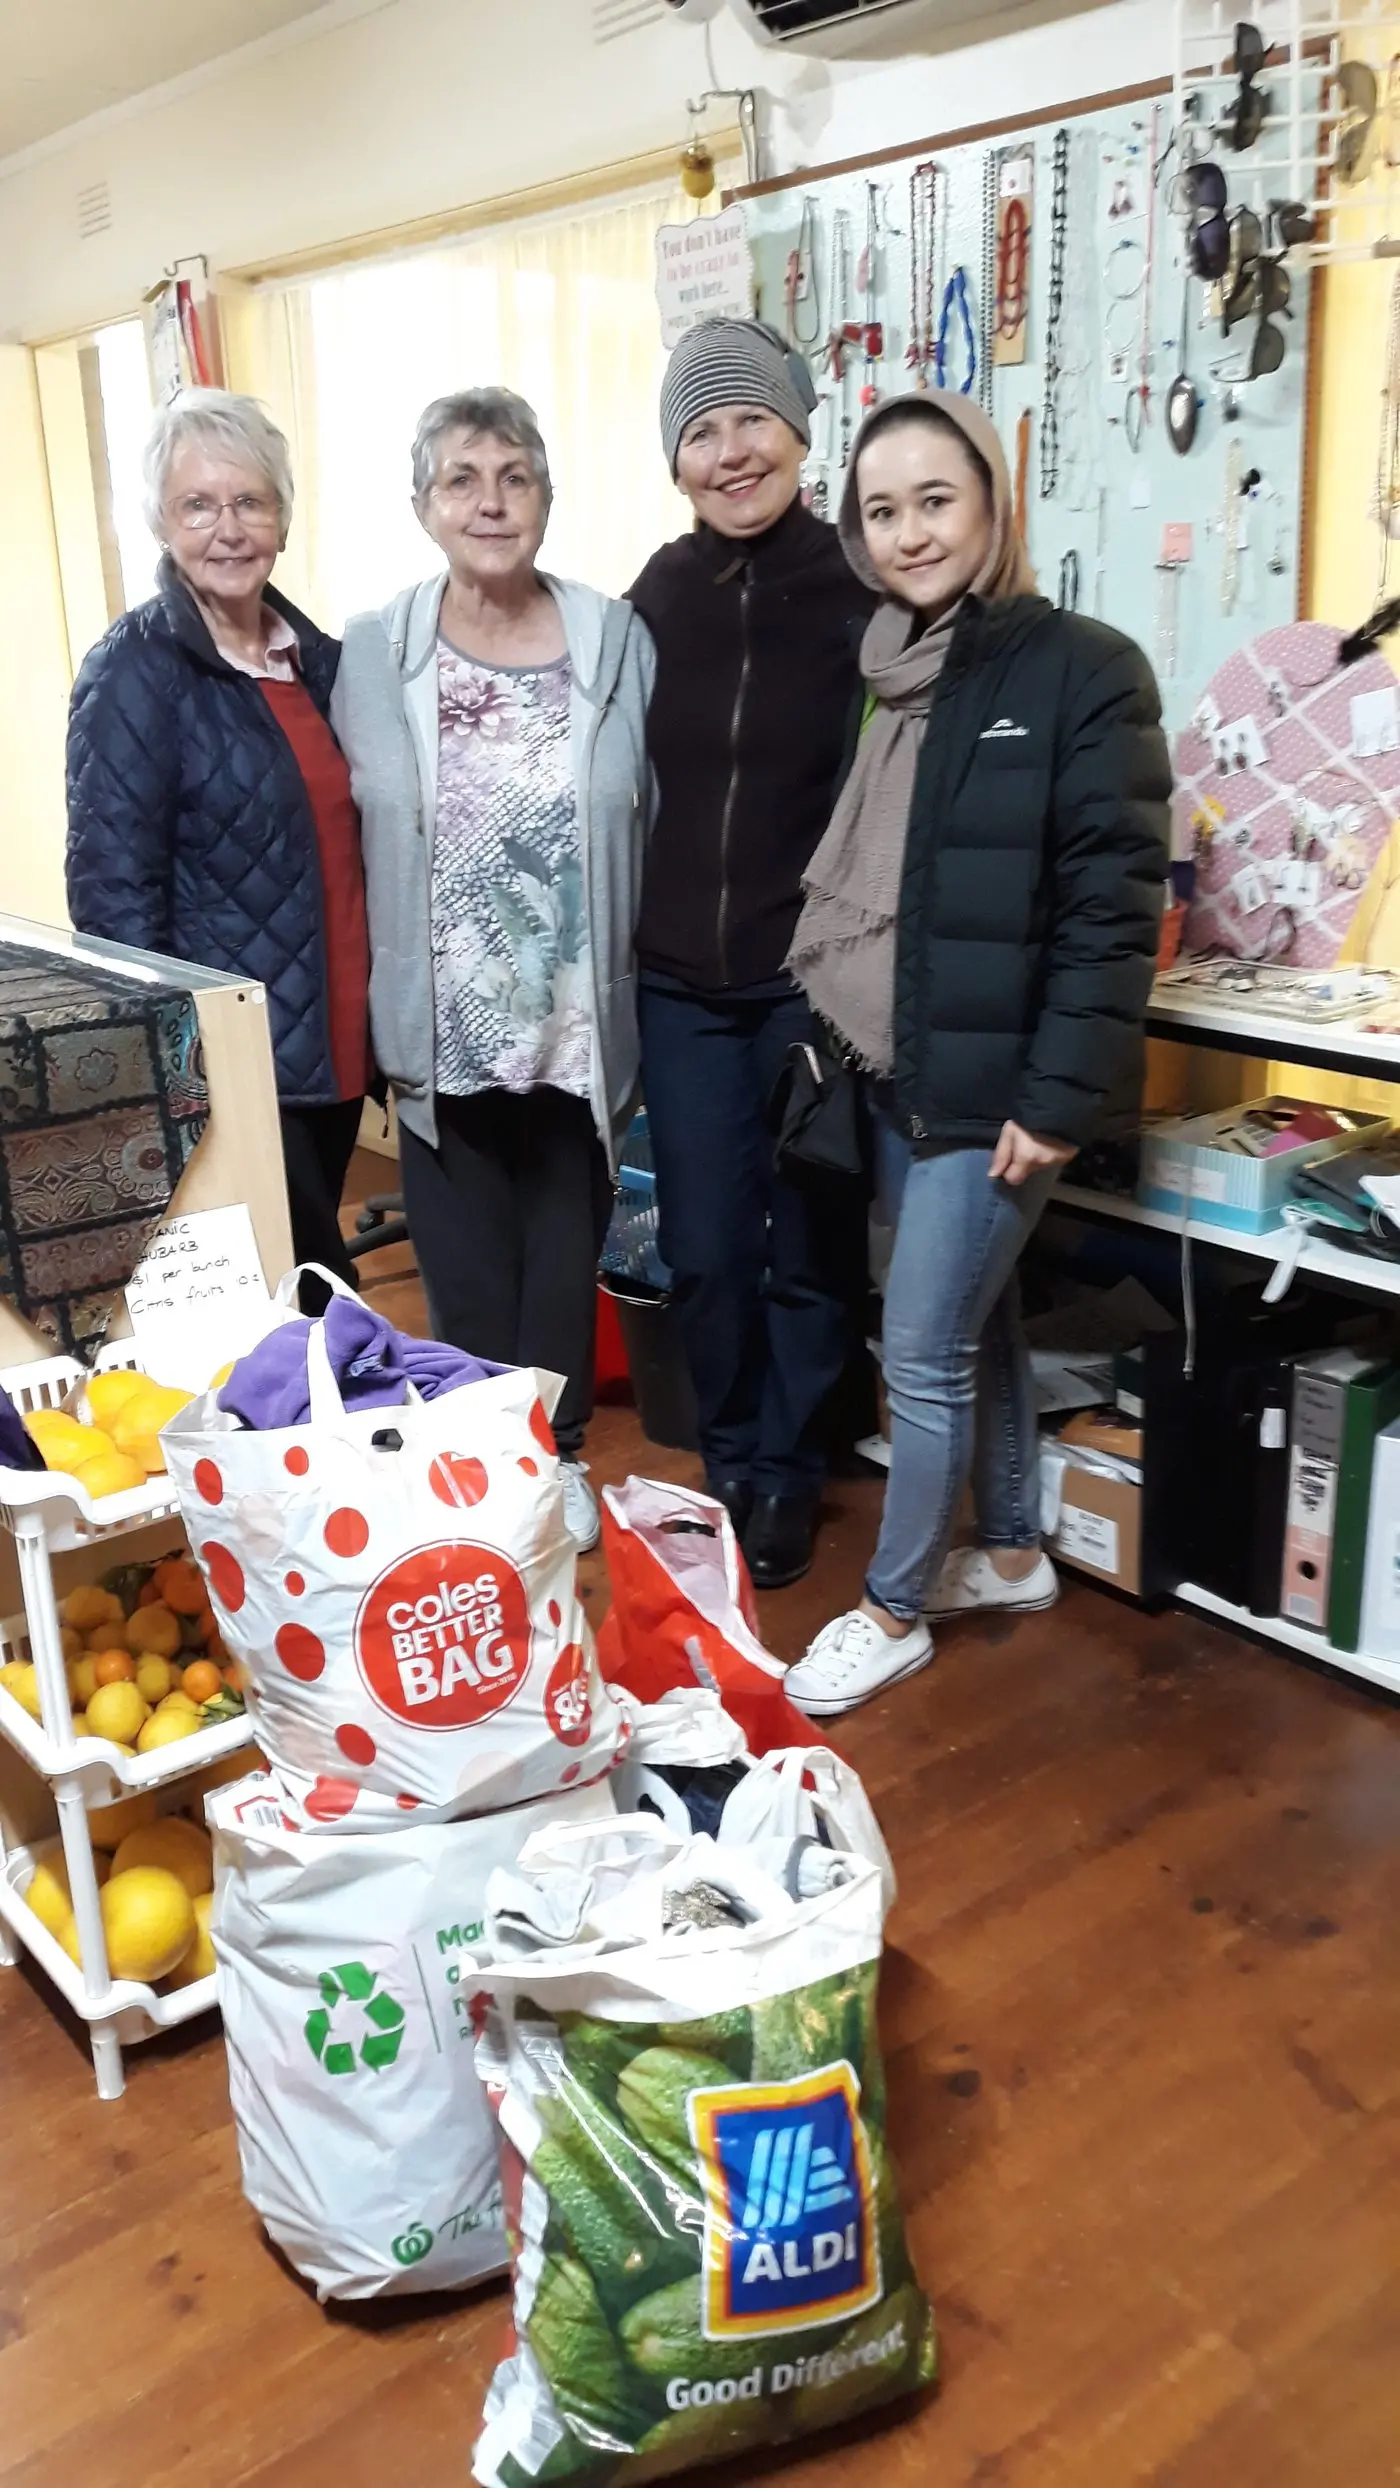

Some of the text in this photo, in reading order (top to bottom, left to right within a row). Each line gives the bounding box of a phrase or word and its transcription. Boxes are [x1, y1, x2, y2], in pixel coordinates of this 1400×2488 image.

[162, 1270, 181, 1283] per
[191, 1255, 230, 1272] bunch
[386, 1573, 500, 1630] coles
[391, 1603, 504, 1661] BETTER
[396, 1628, 515, 1707] BAG
[742, 2222, 857, 2284] ALDI
[665, 2366, 763, 2411] Good
